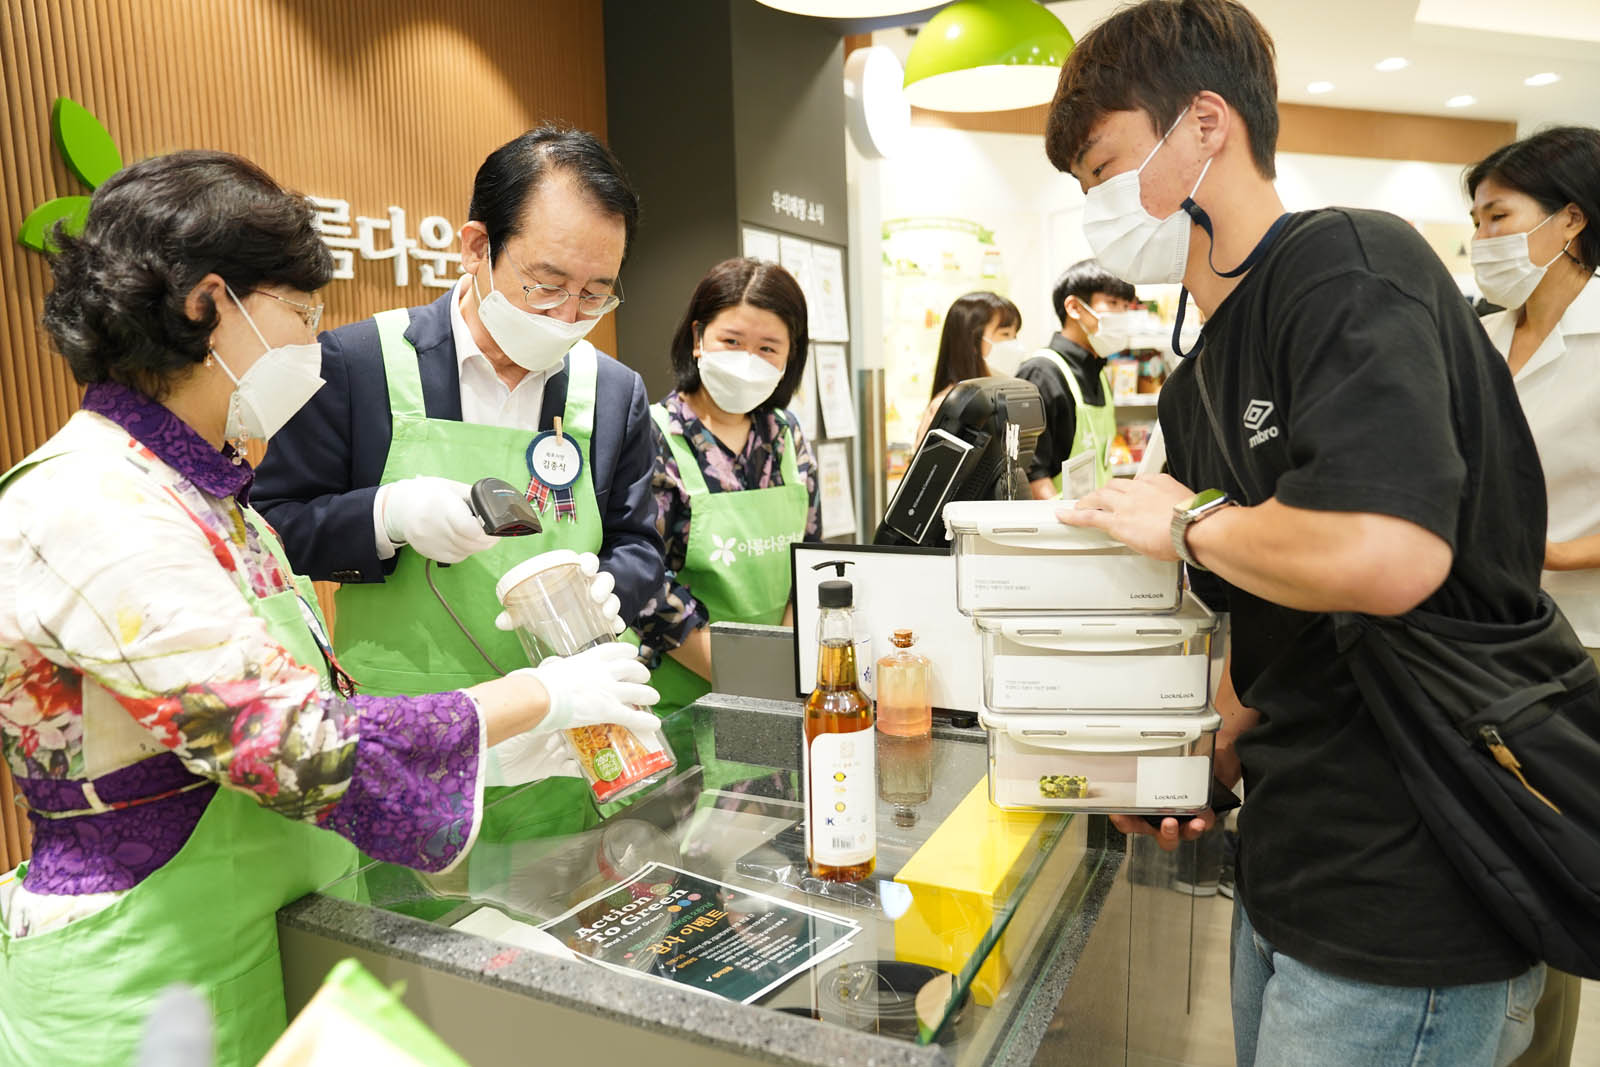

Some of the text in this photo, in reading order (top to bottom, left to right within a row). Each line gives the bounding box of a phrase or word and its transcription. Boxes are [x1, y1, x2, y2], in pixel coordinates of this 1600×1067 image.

[304, 196, 464, 288] 름다운
[1249, 426, 1279, 448] mbro
[1160, 691, 1194, 699] LocknLock
[574, 895, 653, 938] Action
[585, 926, 622, 943] To
[620, 889, 689, 926] Green
[645, 935, 687, 954] 감사
[680, 909, 728, 935] 이벤트
